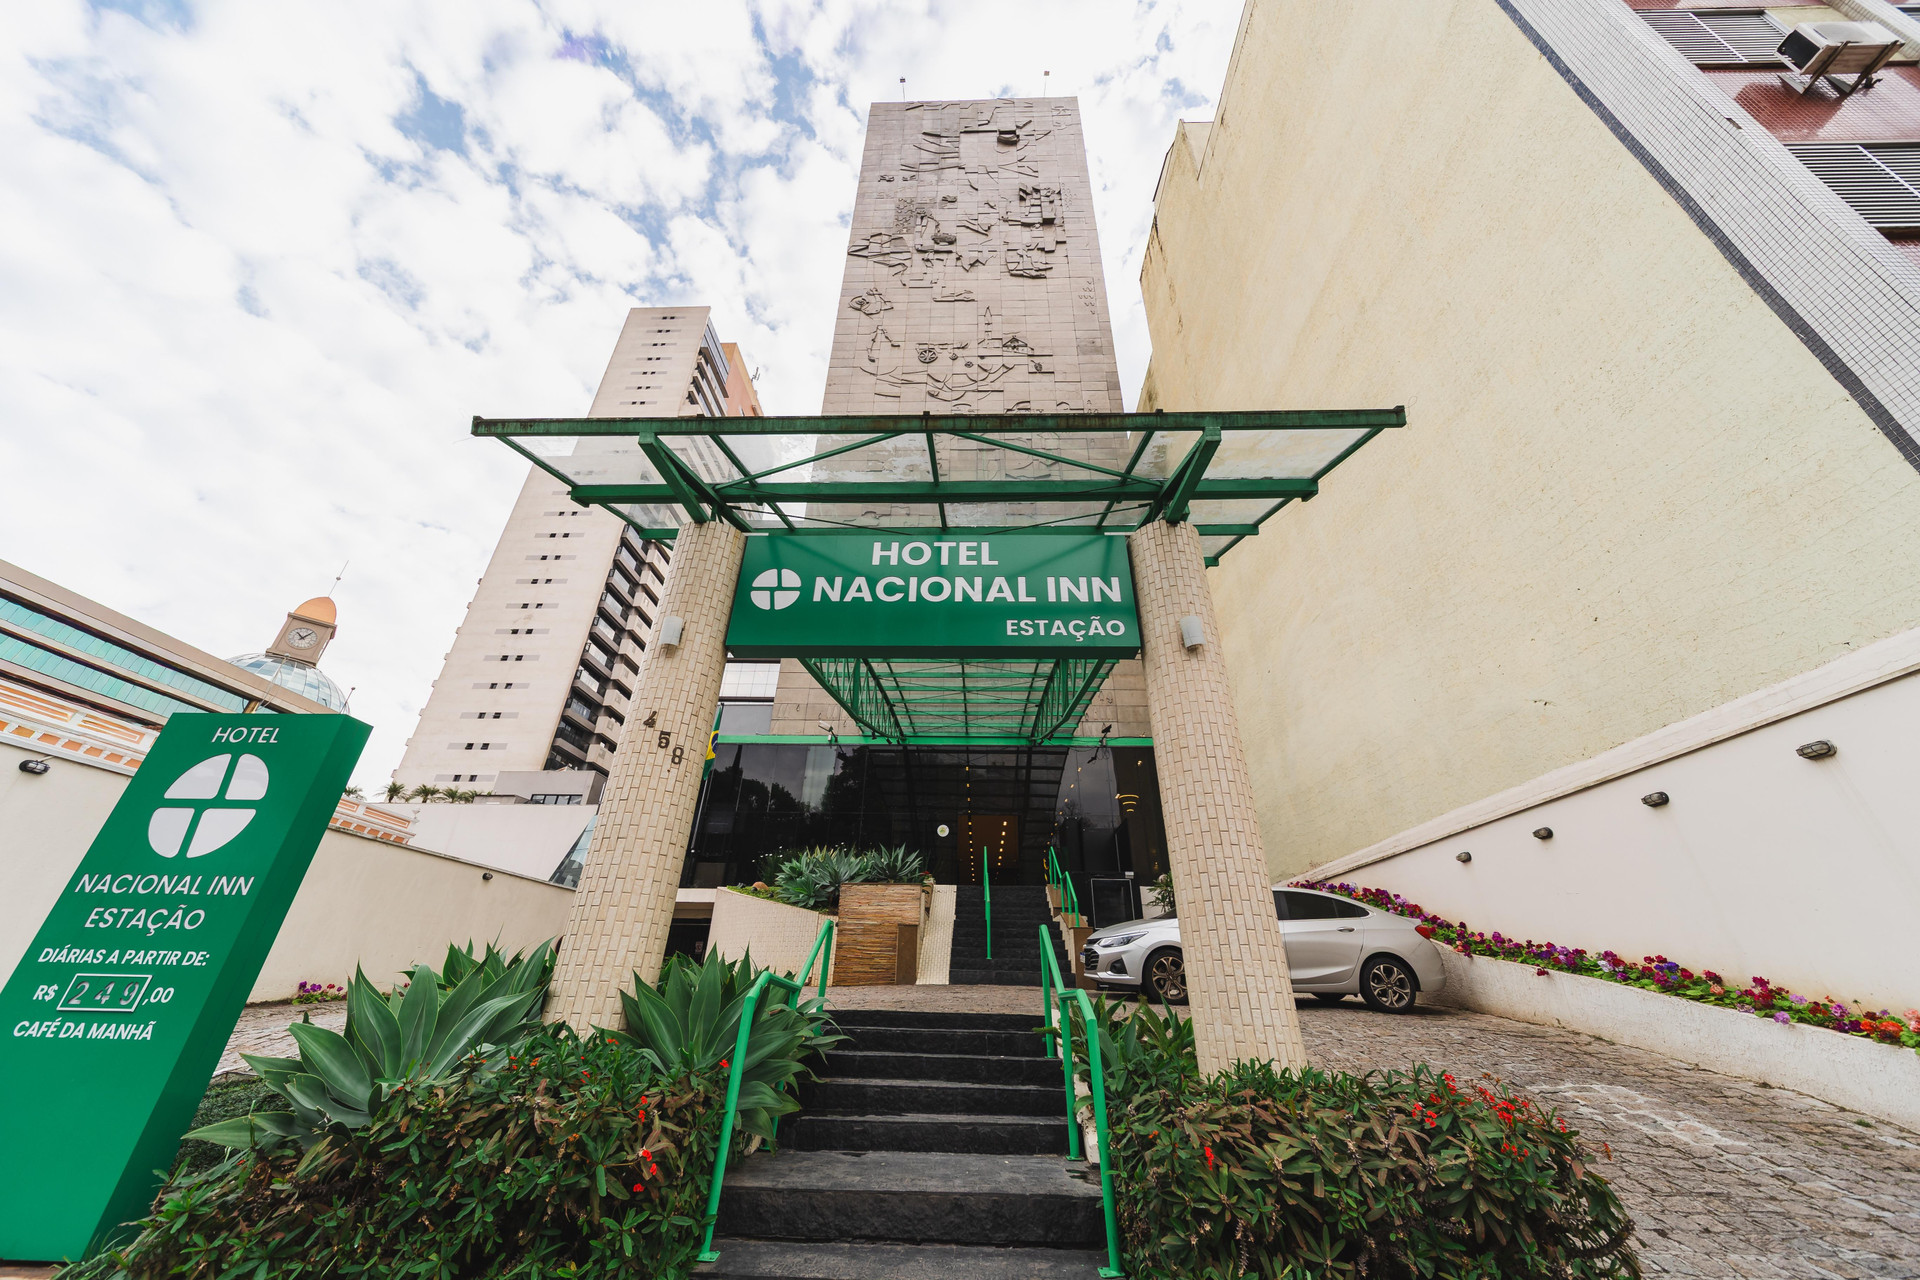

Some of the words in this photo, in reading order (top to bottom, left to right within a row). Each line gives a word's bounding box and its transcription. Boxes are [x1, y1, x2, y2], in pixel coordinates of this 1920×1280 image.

[871, 541, 998, 566] HOTEL
[812, 576, 1036, 603] NACIONAL
[1046, 576, 1122, 603] INN
[1006, 615, 1126, 642] ESTAÇÃO
[211, 727, 280, 743] HOTEL
[643, 710, 684, 765] 458
[74, 873, 203, 895] NACIONAL
[206, 875, 255, 896] INN
[84, 904, 206, 936] ESTAÇÃO
[38, 944, 107, 964] DIÁRIAS
[105, 950, 118, 965] A
[121, 950, 182, 966] PARTIR
[181, 951, 210, 966] DE:
[33, 984, 59, 1002] R$
[13, 1017, 63, 1038] CAFÉ
[58, 1022, 86, 1039] DA
[86, 1020, 157, 1041] MANHÃ
